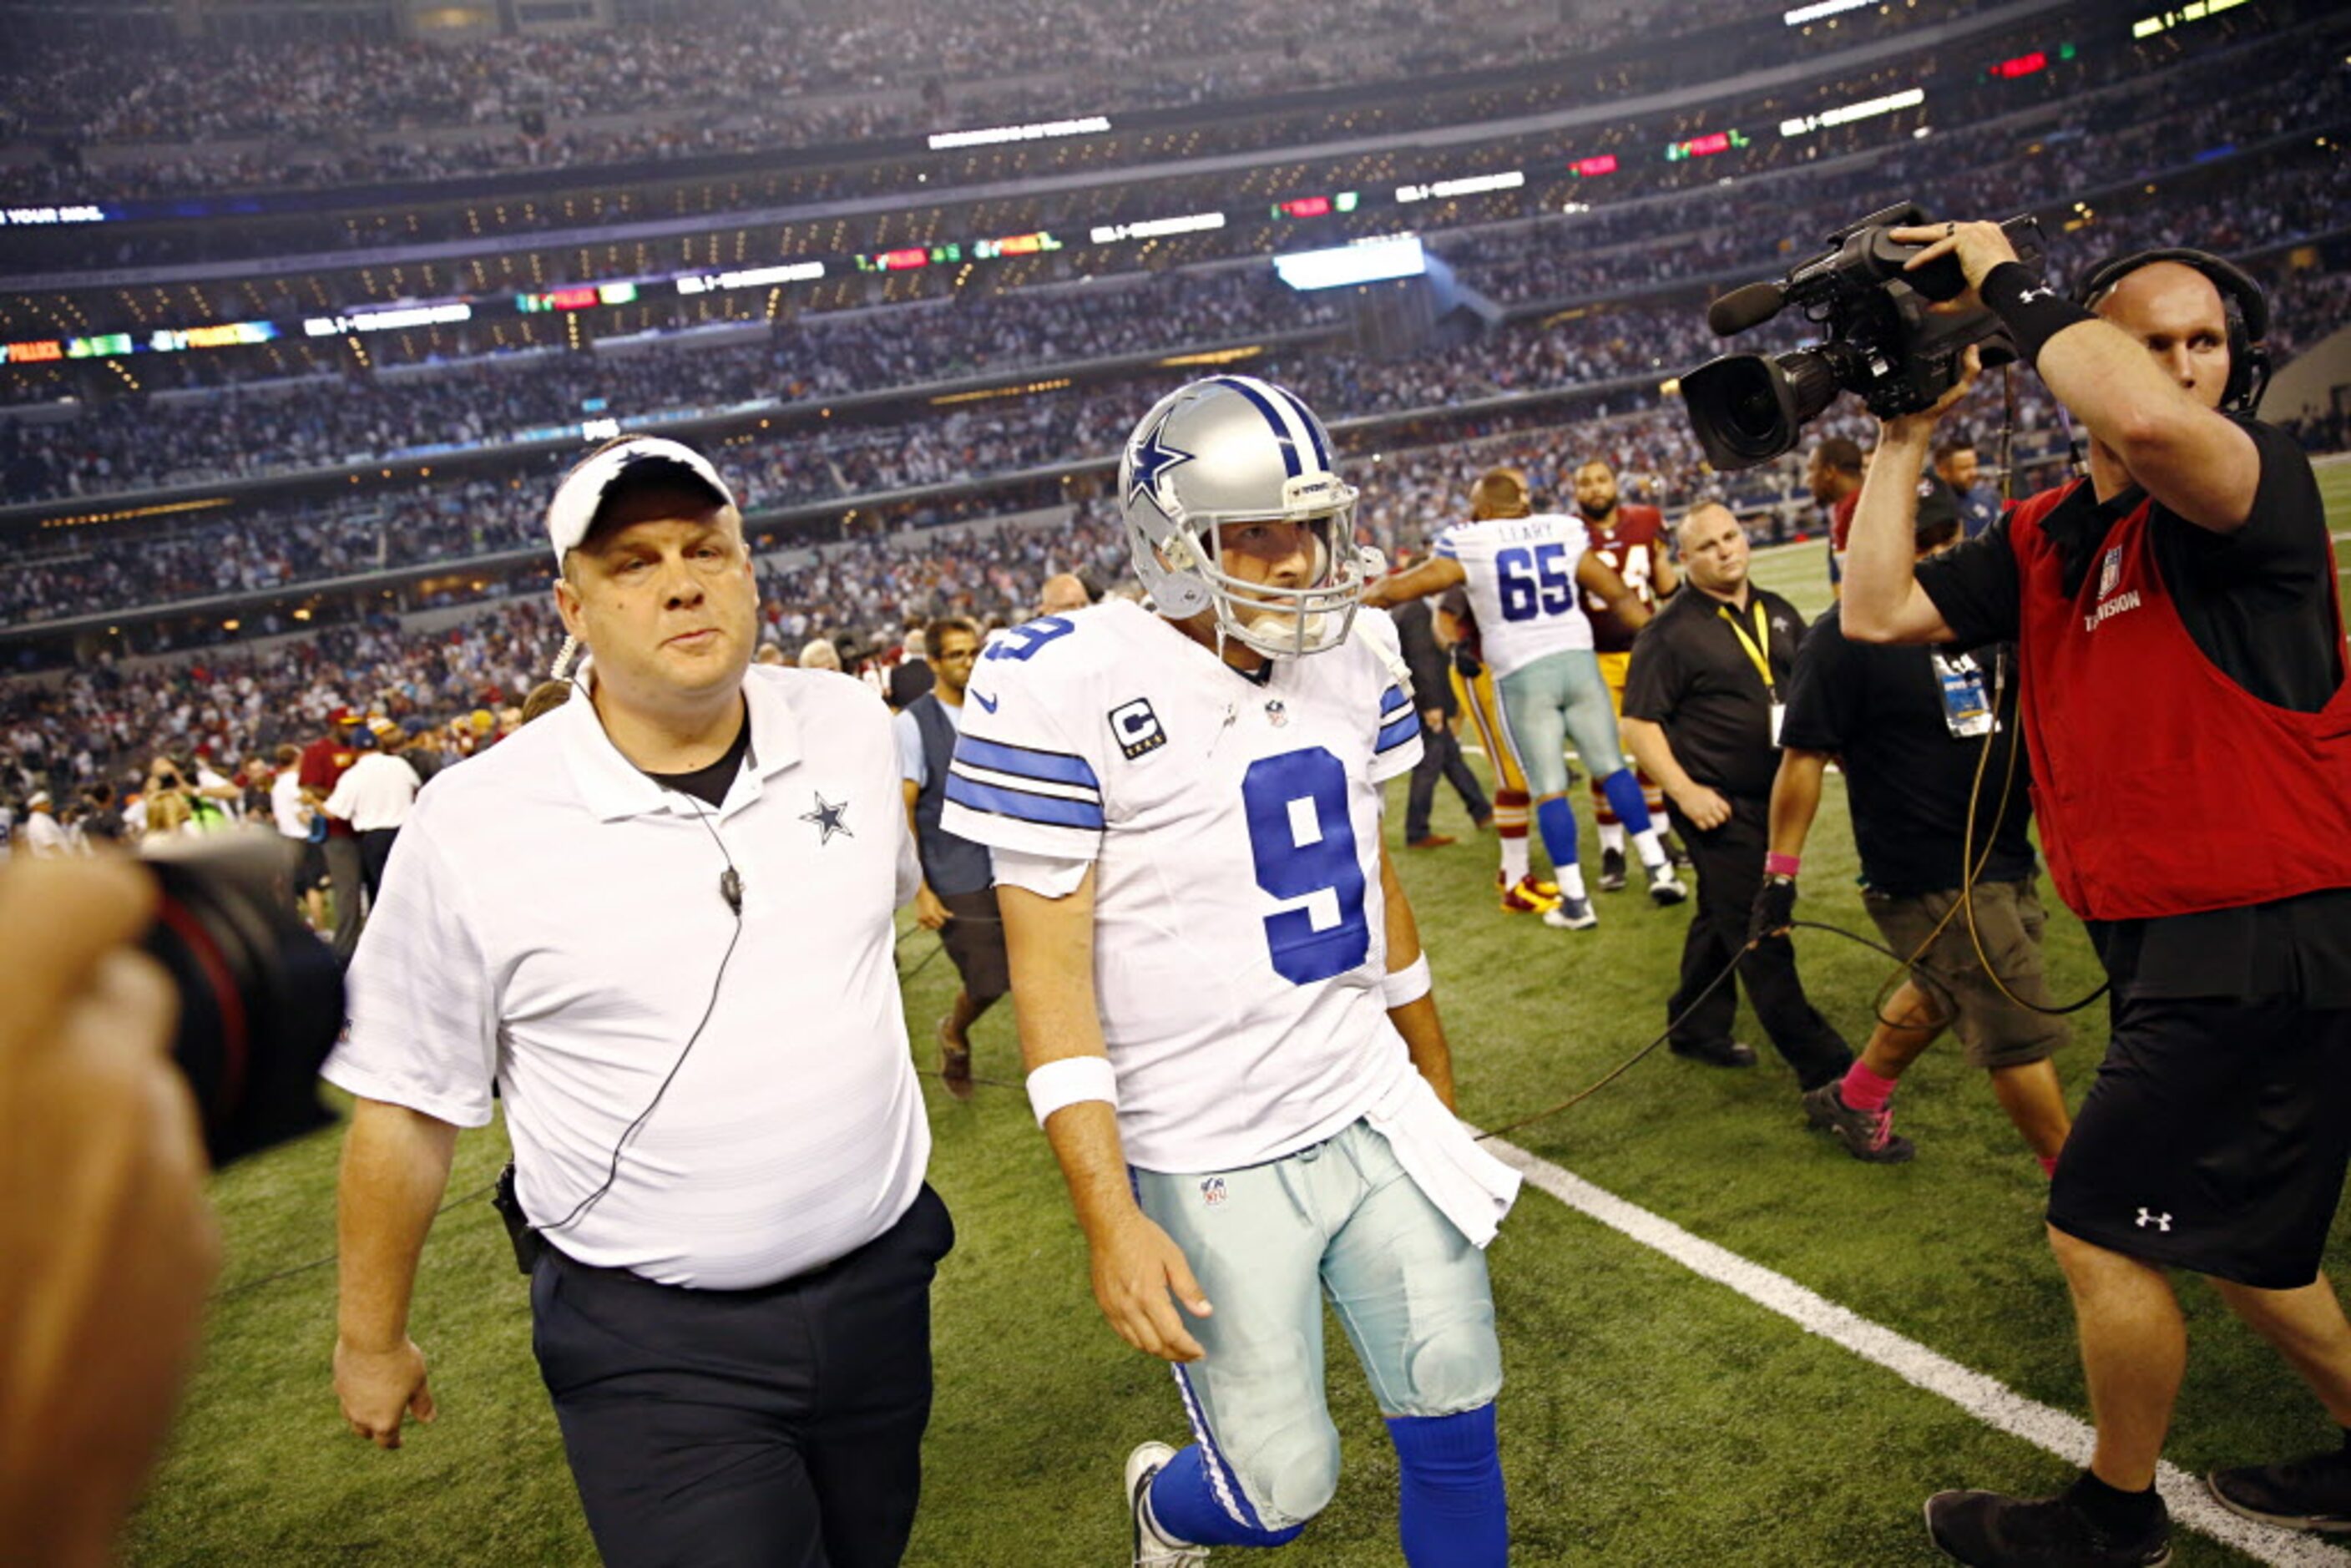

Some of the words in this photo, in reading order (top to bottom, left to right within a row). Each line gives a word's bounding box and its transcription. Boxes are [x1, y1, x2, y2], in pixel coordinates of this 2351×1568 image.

[7, 208, 58, 224] YOUR
[1499, 523, 1553, 543] LEARY
[1495, 543, 1574, 623] 65
[1113, 701, 1158, 746] C
[1241, 746, 1368, 986] 9
